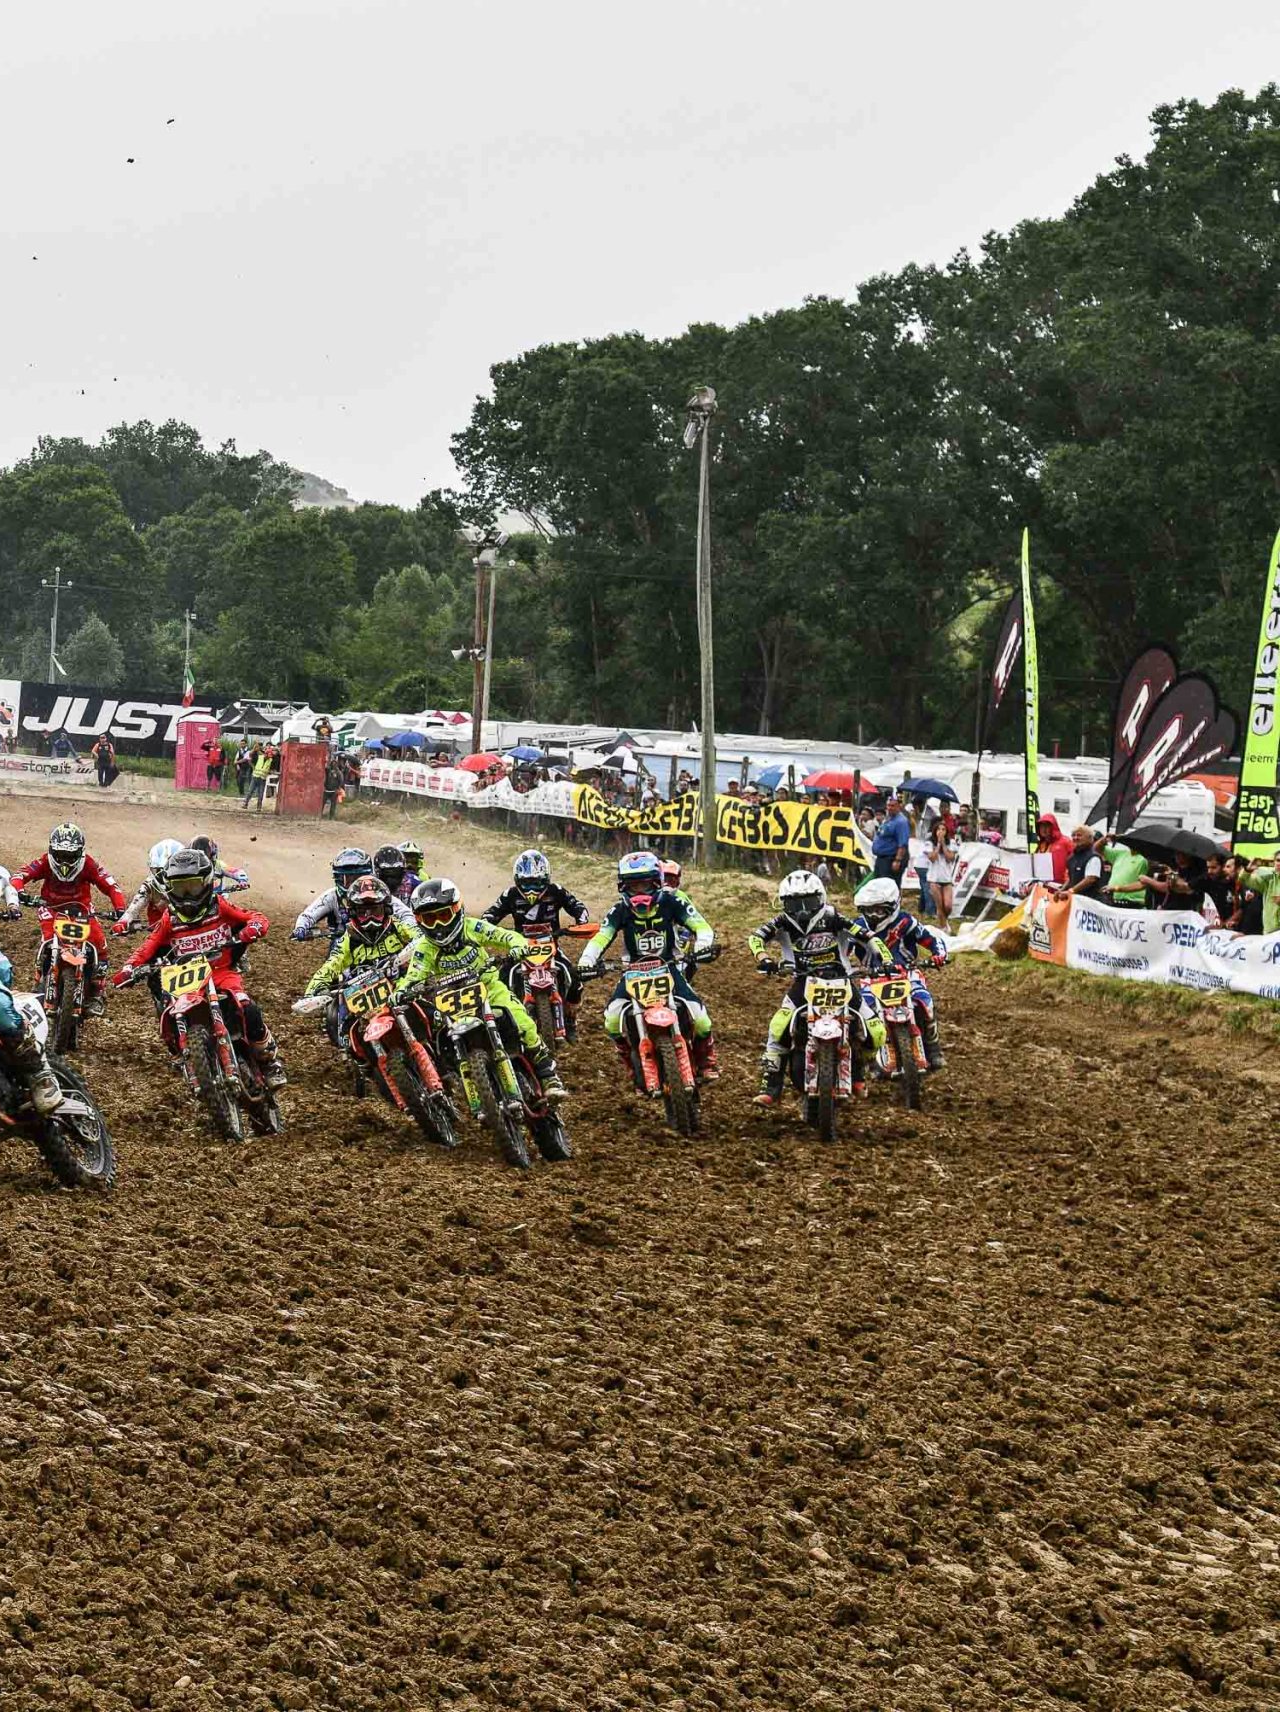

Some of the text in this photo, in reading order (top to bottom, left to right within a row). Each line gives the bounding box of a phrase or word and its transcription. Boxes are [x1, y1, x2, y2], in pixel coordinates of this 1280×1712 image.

[1239, 790, 1275, 815] Easy
[1236, 810, 1280, 839] Flag
[61, 923, 84, 939] 8
[638, 936, 665, 951] 618
[169, 966, 207, 993] 101
[631, 975, 671, 1001] 179
[880, 981, 907, 1000] 6
[351, 980, 391, 1013] 310
[440, 984, 482, 1013] 33
[812, 987, 847, 1007] 212
